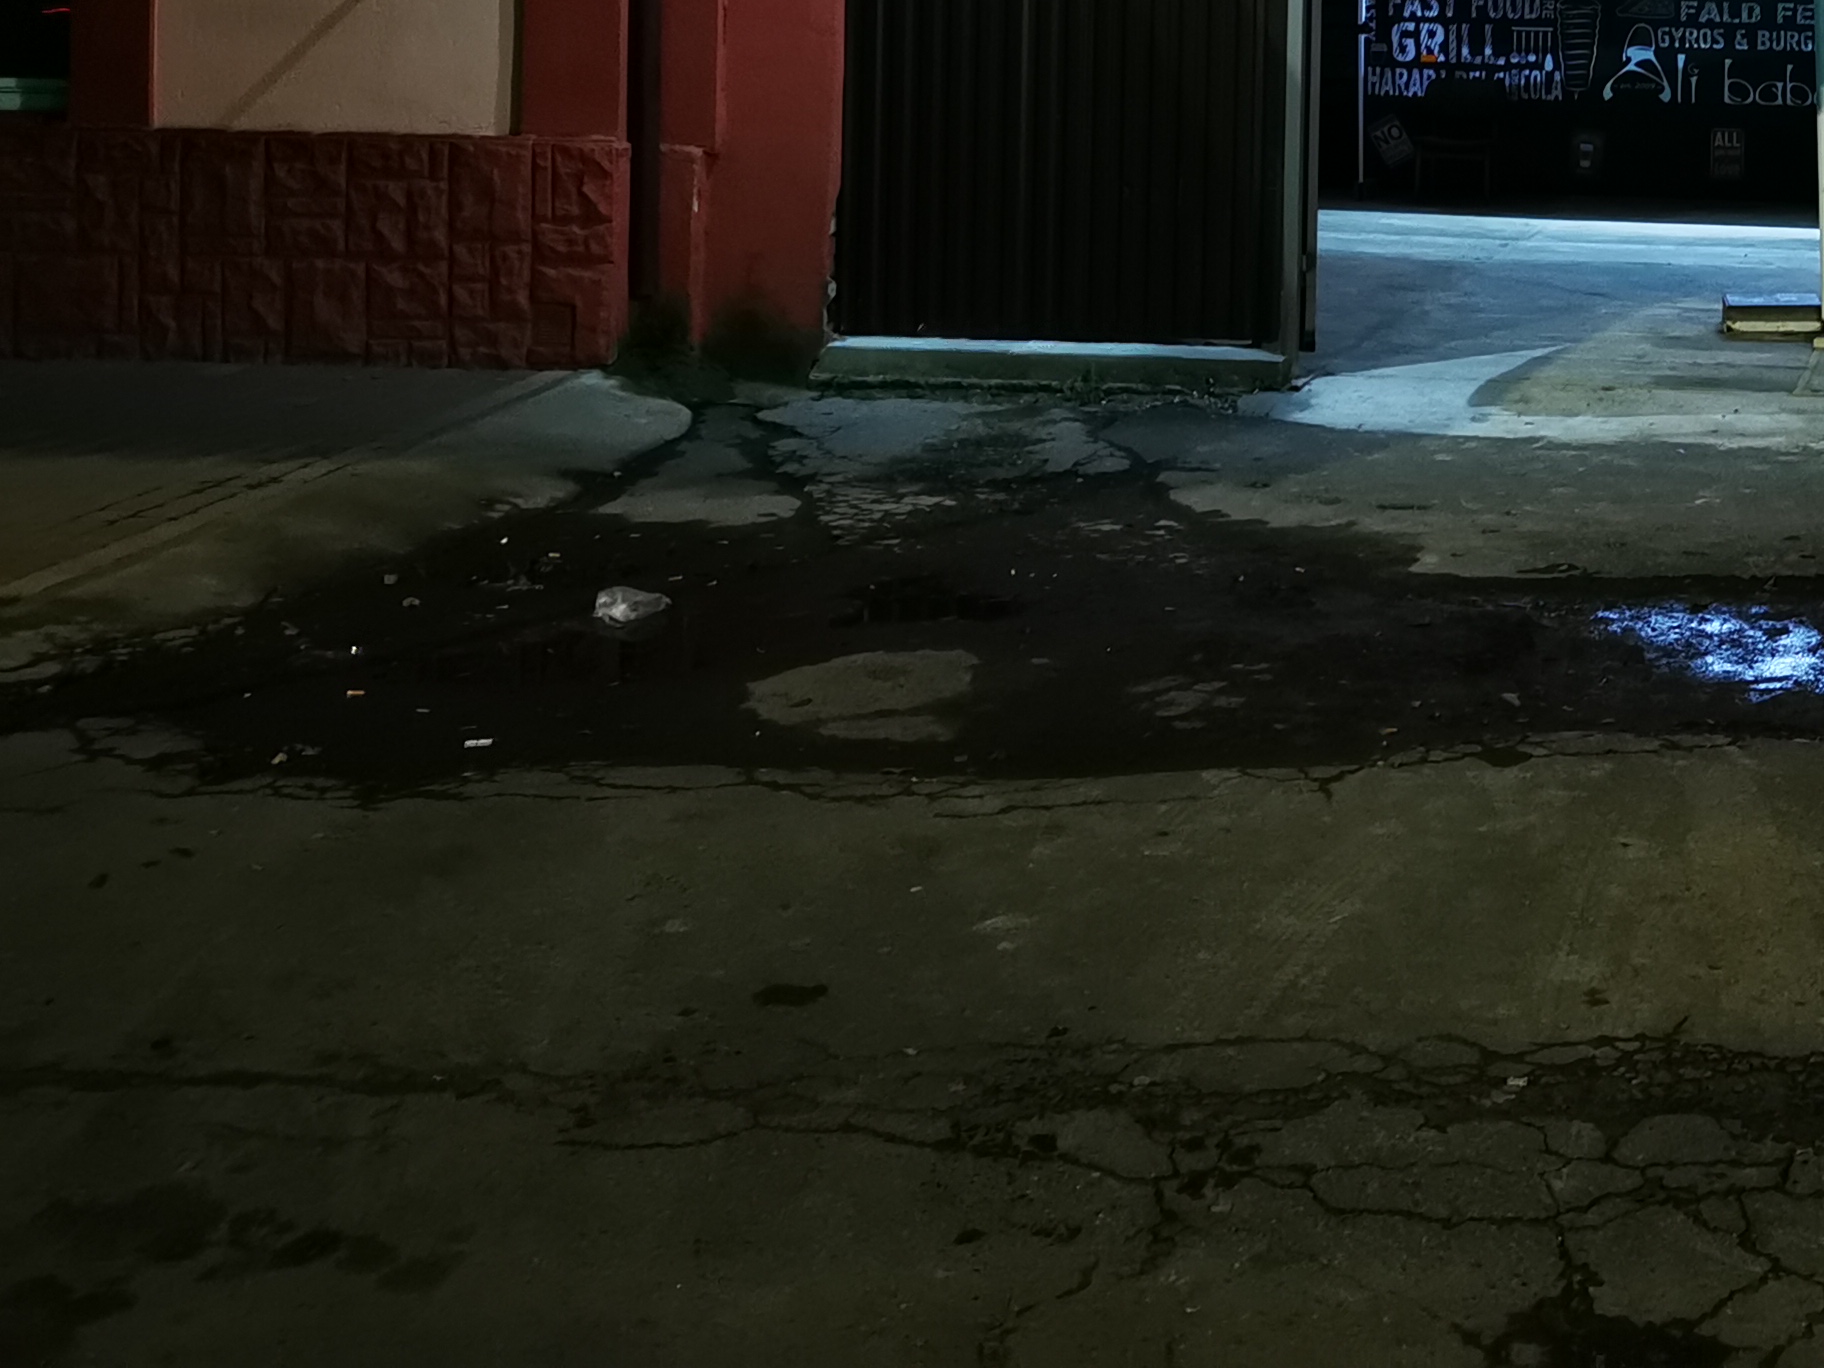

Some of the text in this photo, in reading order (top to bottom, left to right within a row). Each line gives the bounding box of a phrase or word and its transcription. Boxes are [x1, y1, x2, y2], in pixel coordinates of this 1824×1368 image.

[1680, 0, 1815, 25] FALD FE
[1391, 21, 1507, 66] GRILL
[1657, 26, 1816, 52] GYROS & BURG
[1602, 22, 1818, 106] Ali bab
[1367, 65, 1447, 98] HARAP
[1373, 124, 1403, 150] NO
[1714, 131, 1741, 147] ALL
